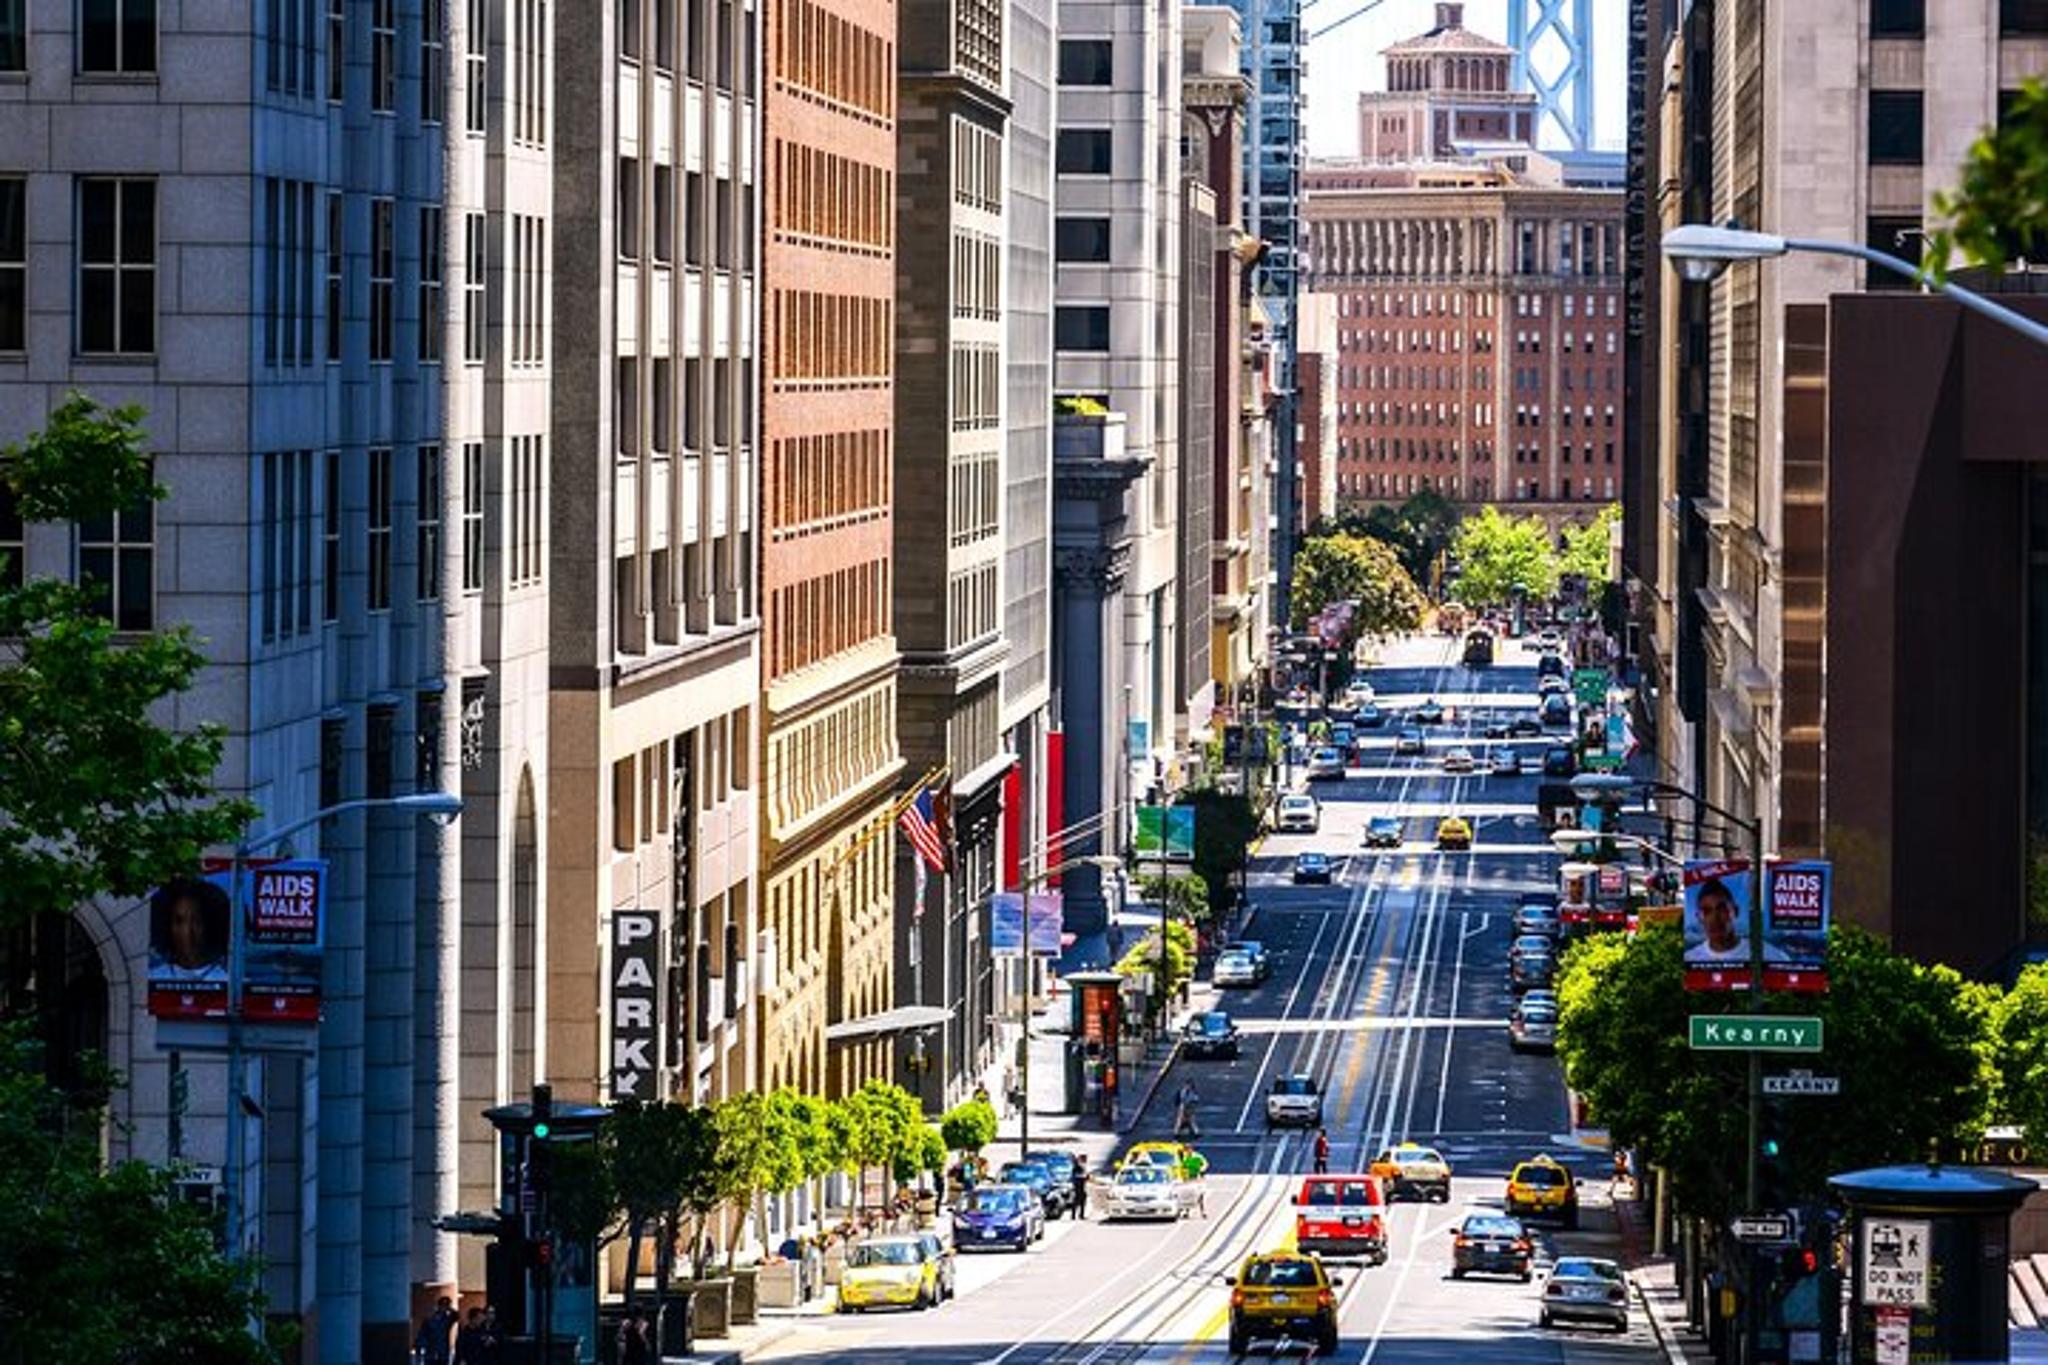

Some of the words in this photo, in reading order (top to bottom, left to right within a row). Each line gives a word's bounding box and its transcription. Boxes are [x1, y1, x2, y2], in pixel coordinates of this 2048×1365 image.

[259, 875, 314, 897] AIDS
[1774, 875, 1820, 892] AIDS
[258, 898, 314, 917] WALK
[1773, 892, 1819, 908] WALK
[614, 916, 654, 1069] PARK
[1705, 1023, 1805, 1046] Kearny
[1768, 1078, 1835, 1091] KEARNY
[1869, 1271, 1889, 1283] DO
[1895, 1272, 1922, 1285] NOT
[1877, 1287, 1915, 1301] PASS
